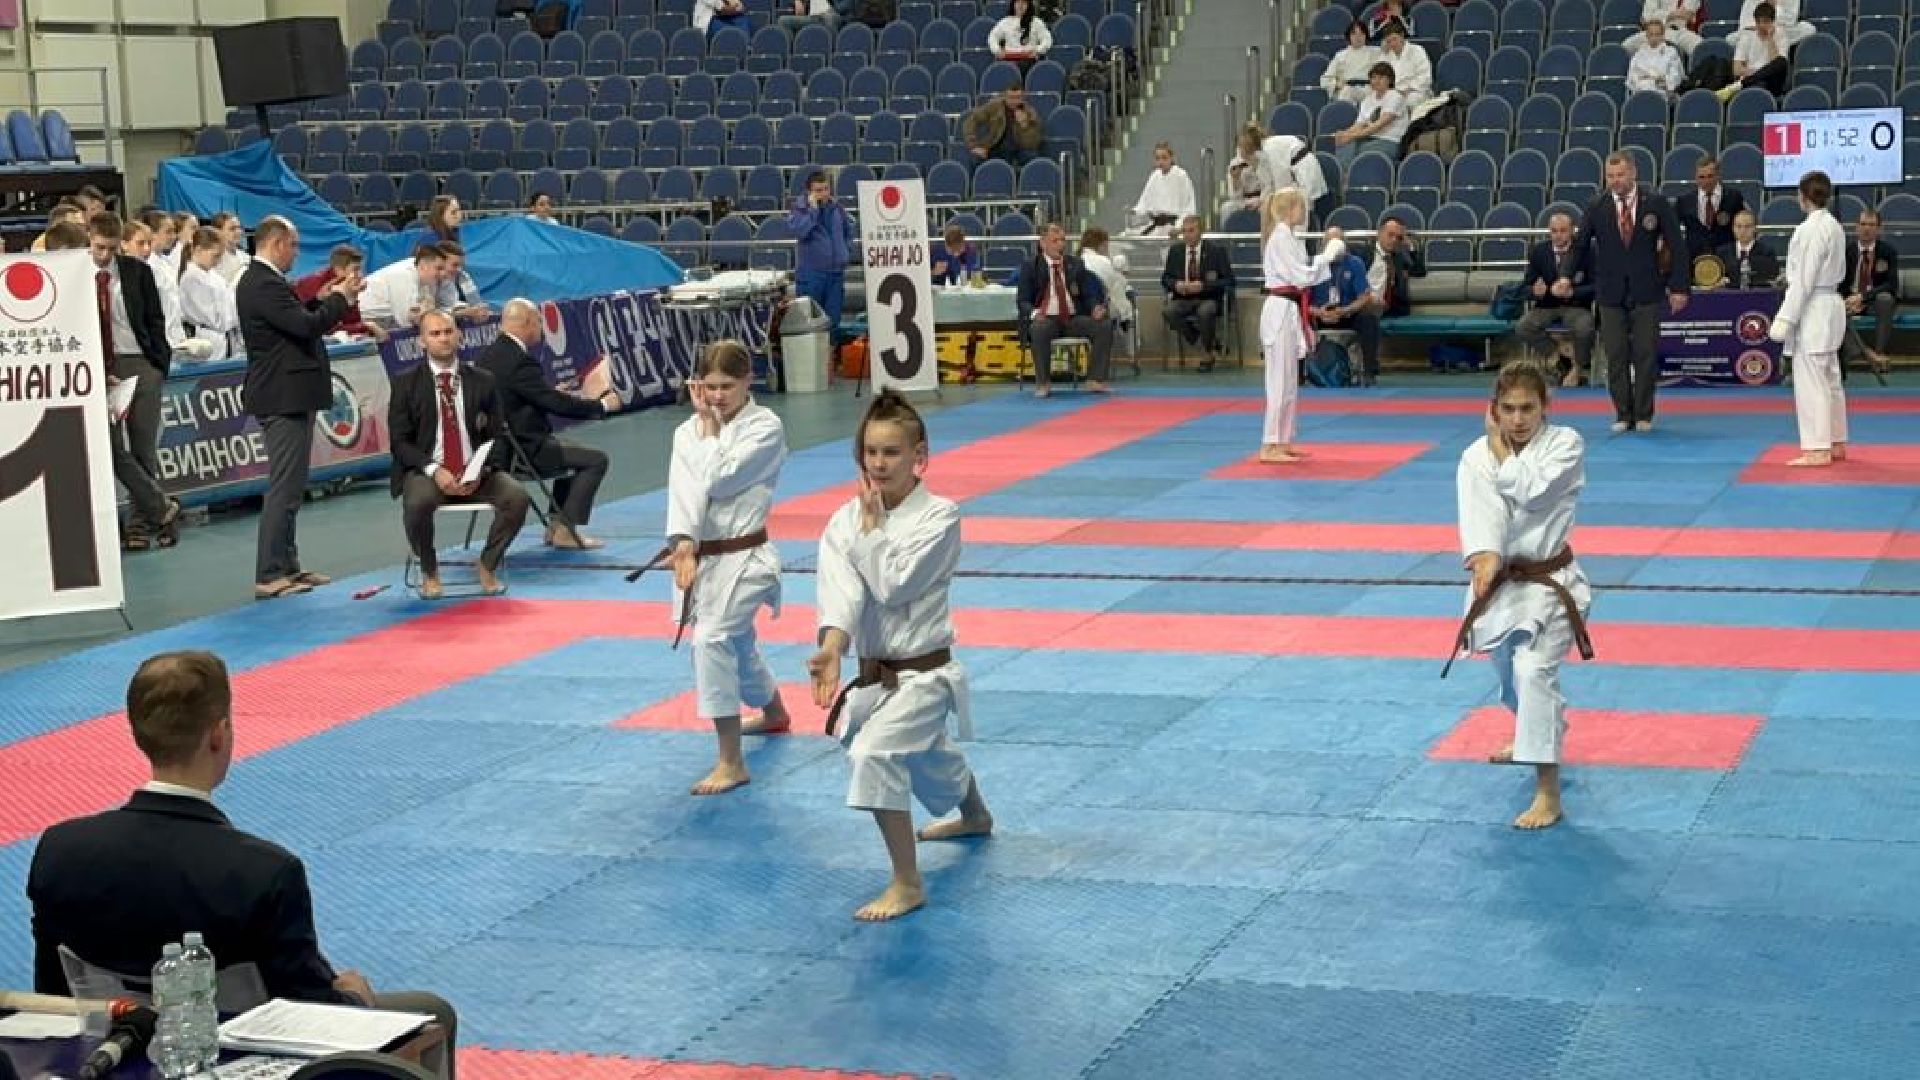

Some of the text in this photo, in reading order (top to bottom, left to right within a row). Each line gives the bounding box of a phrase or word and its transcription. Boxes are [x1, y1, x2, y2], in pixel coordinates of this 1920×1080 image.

[1775, 121, 1895, 153] 1 01:52 0
[868, 243, 922, 268] SHIAI JO
[877, 273, 924, 380] 3
[60, 361, 92, 398] JO
[0, 405, 101, 591] 1
